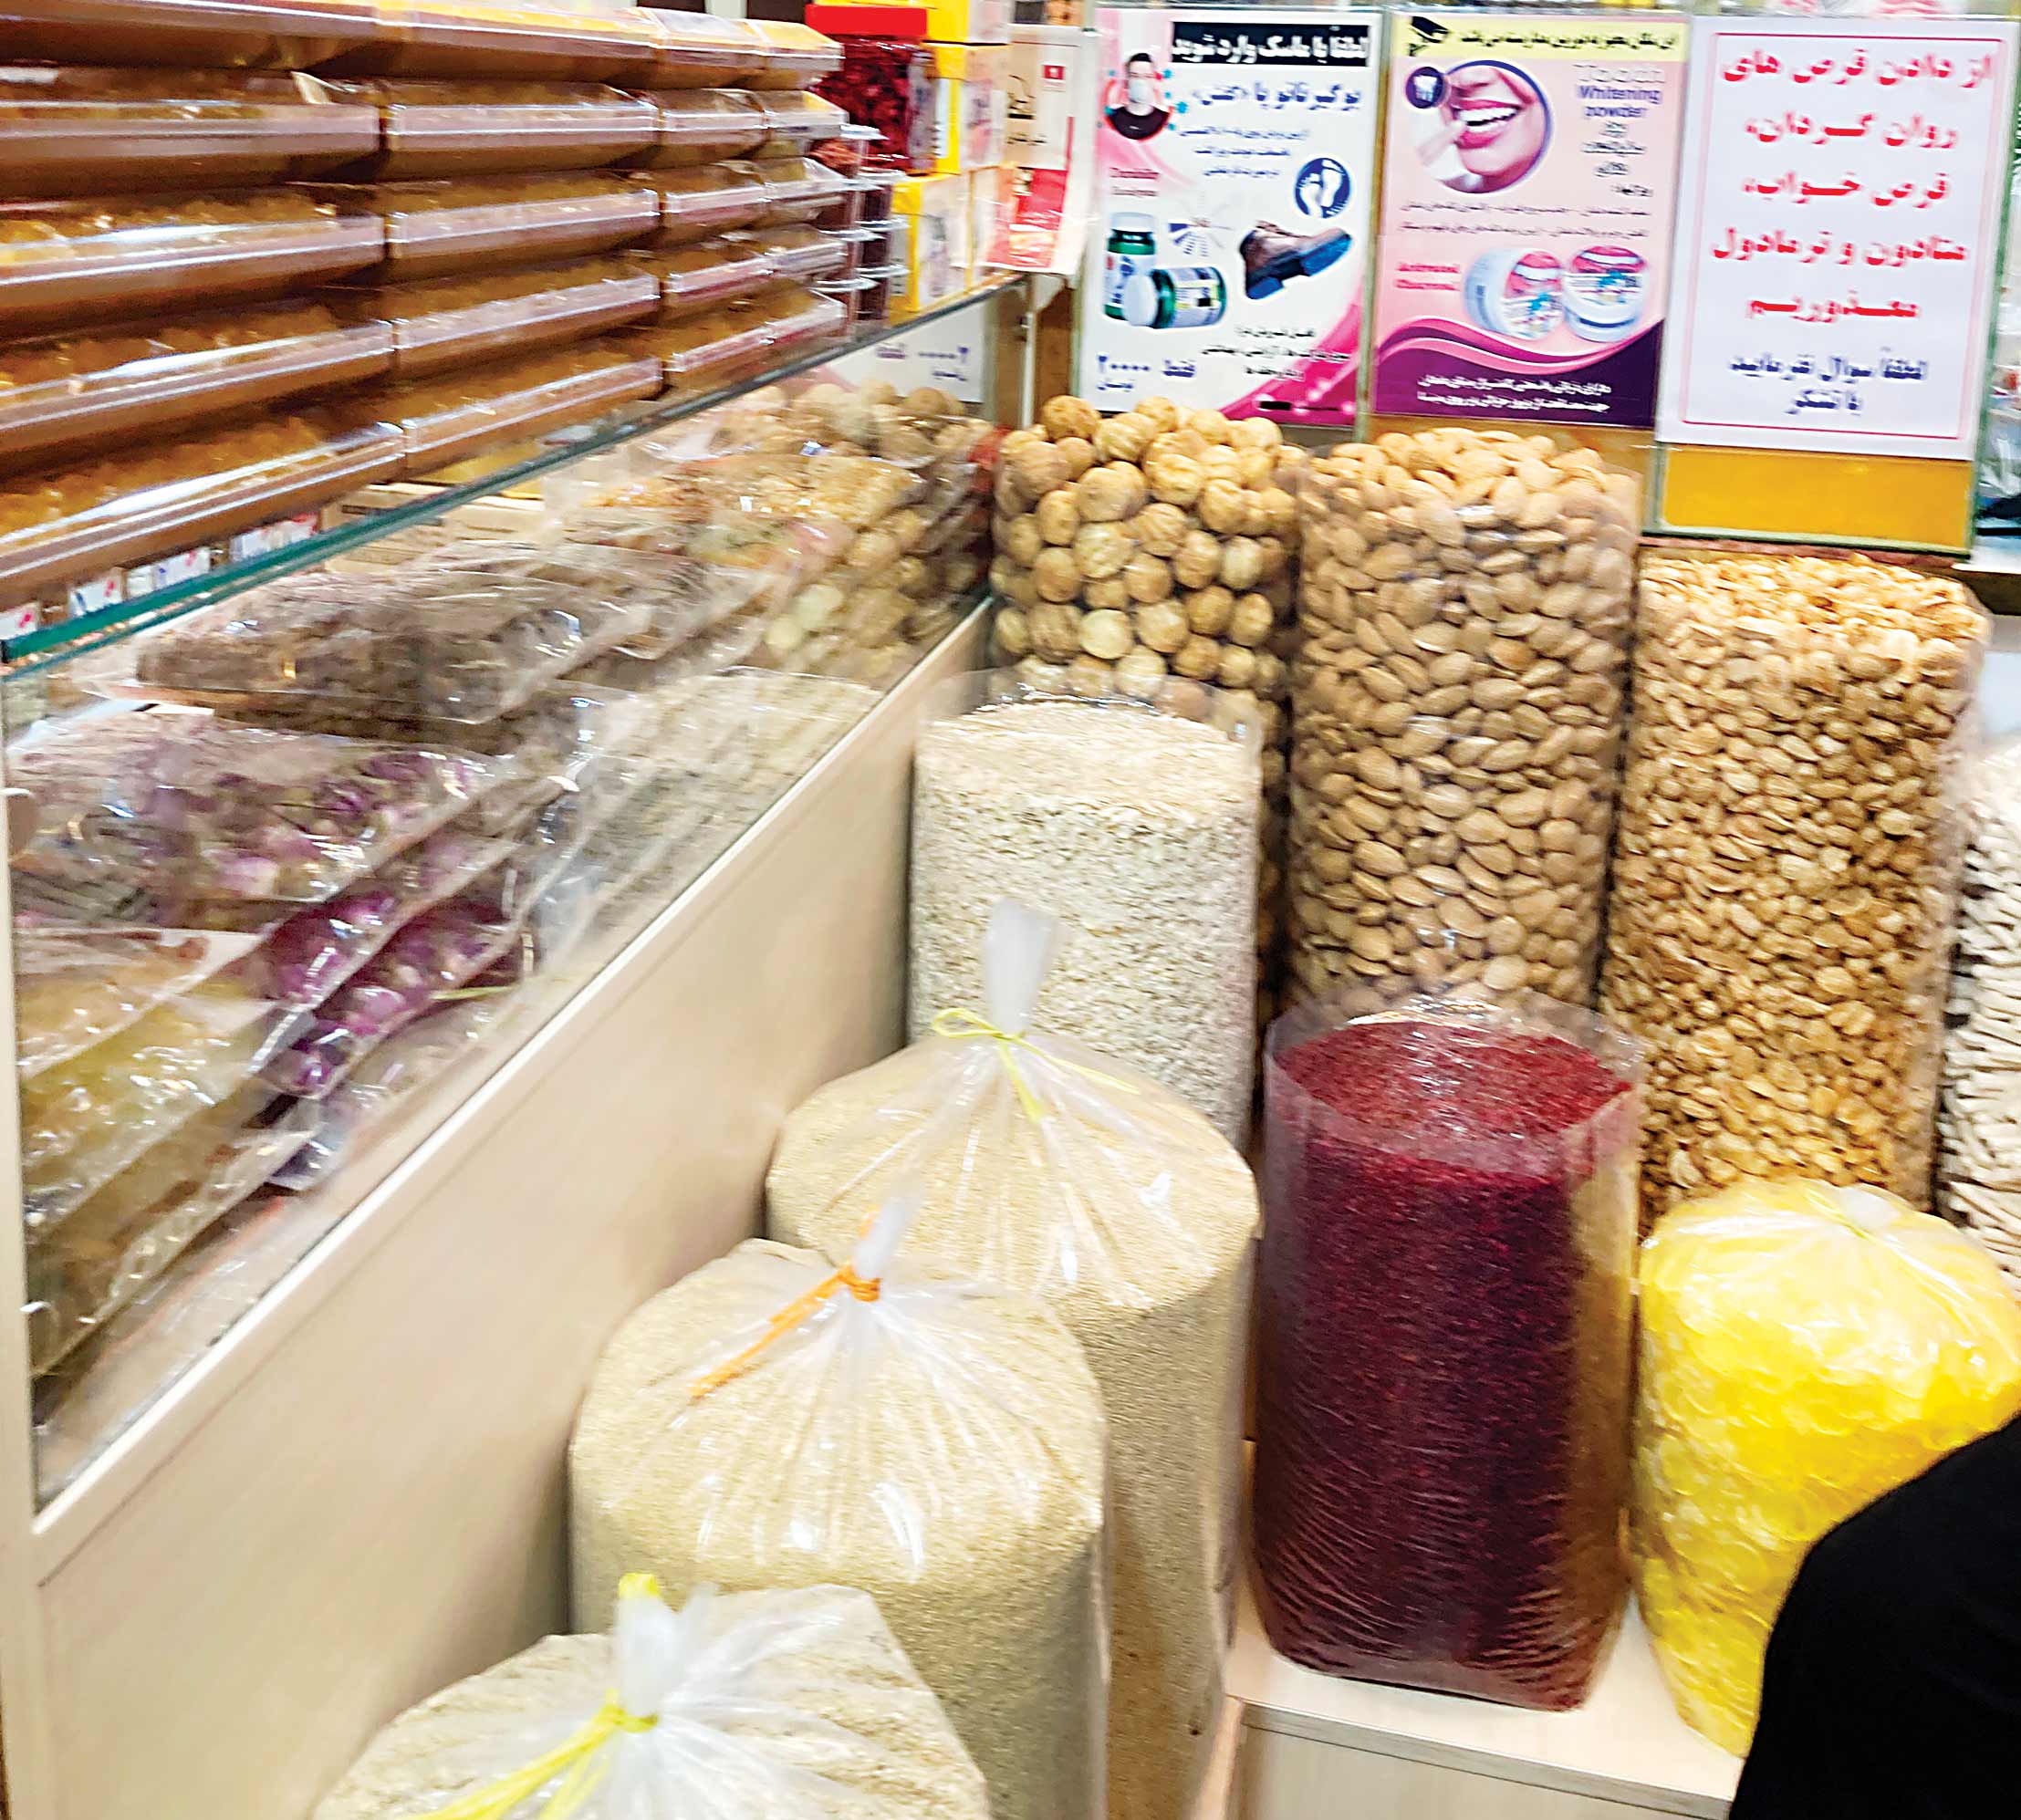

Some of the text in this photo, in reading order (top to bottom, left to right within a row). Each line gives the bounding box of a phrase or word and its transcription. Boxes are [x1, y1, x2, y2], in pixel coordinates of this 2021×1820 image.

[1172, 33, 1215, 63] شوید
[1215, 34, 1257, 65] وارد
[1257, 35, 1310, 58] ماسک
[1723, 48, 1993, 88] از دادن قرص های
[1576, 85, 1662, 105] Whitening
[1583, 106, 1648, 120] powder
[1883, 114, 1958, 149] روان
[1871, 172, 1950, 209] قرص
[1712, 225, 1966, 267] متادون و ترمادول
[1745, 289, 1921, 323] معذوریم
[1162, 358, 1196, 378] فقط
[1727, 352, 1816, 381] نفرمایید
[1818, 355, 1873, 383] سوال
[1783, 389, 1862, 416] با تشکر
